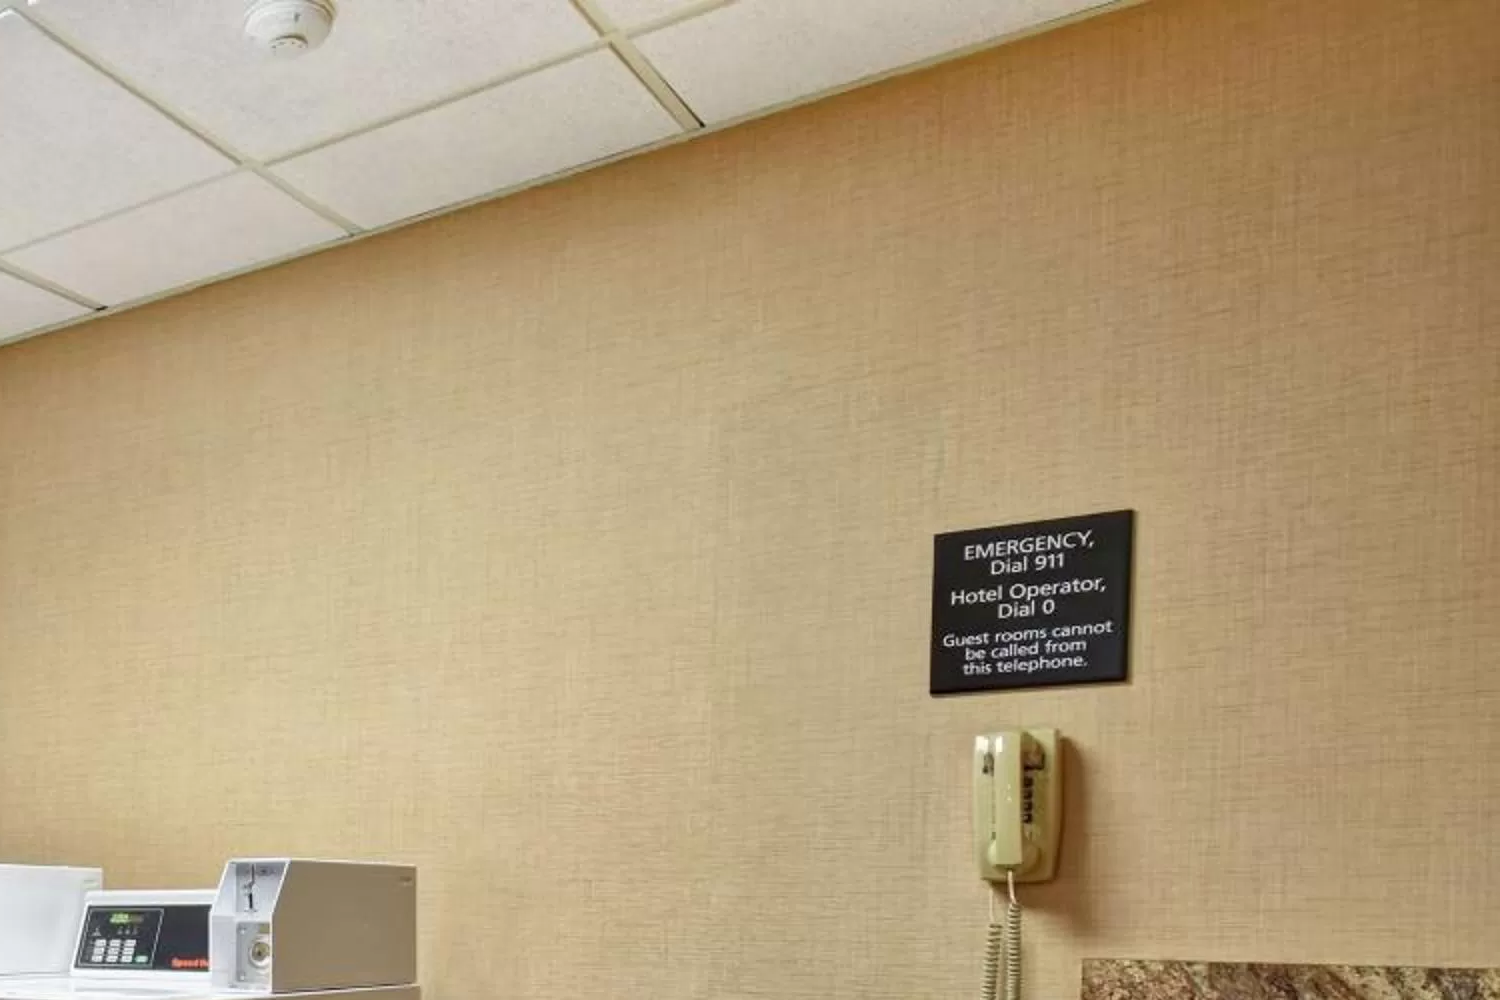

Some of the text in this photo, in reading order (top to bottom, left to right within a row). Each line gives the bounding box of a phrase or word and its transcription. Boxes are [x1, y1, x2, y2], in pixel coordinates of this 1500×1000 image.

[963, 530, 1095, 561] EMERGENCY,
[990, 552, 1065, 576] Dial 911
[950, 577, 1106, 606] Hotel Operator,
[997, 599, 1055, 619] Dial 0
[943, 620, 1113, 648] Guest rooms cannot
[965, 639, 1087, 661] be called from
[963, 654, 1088, 676] this telephone.
